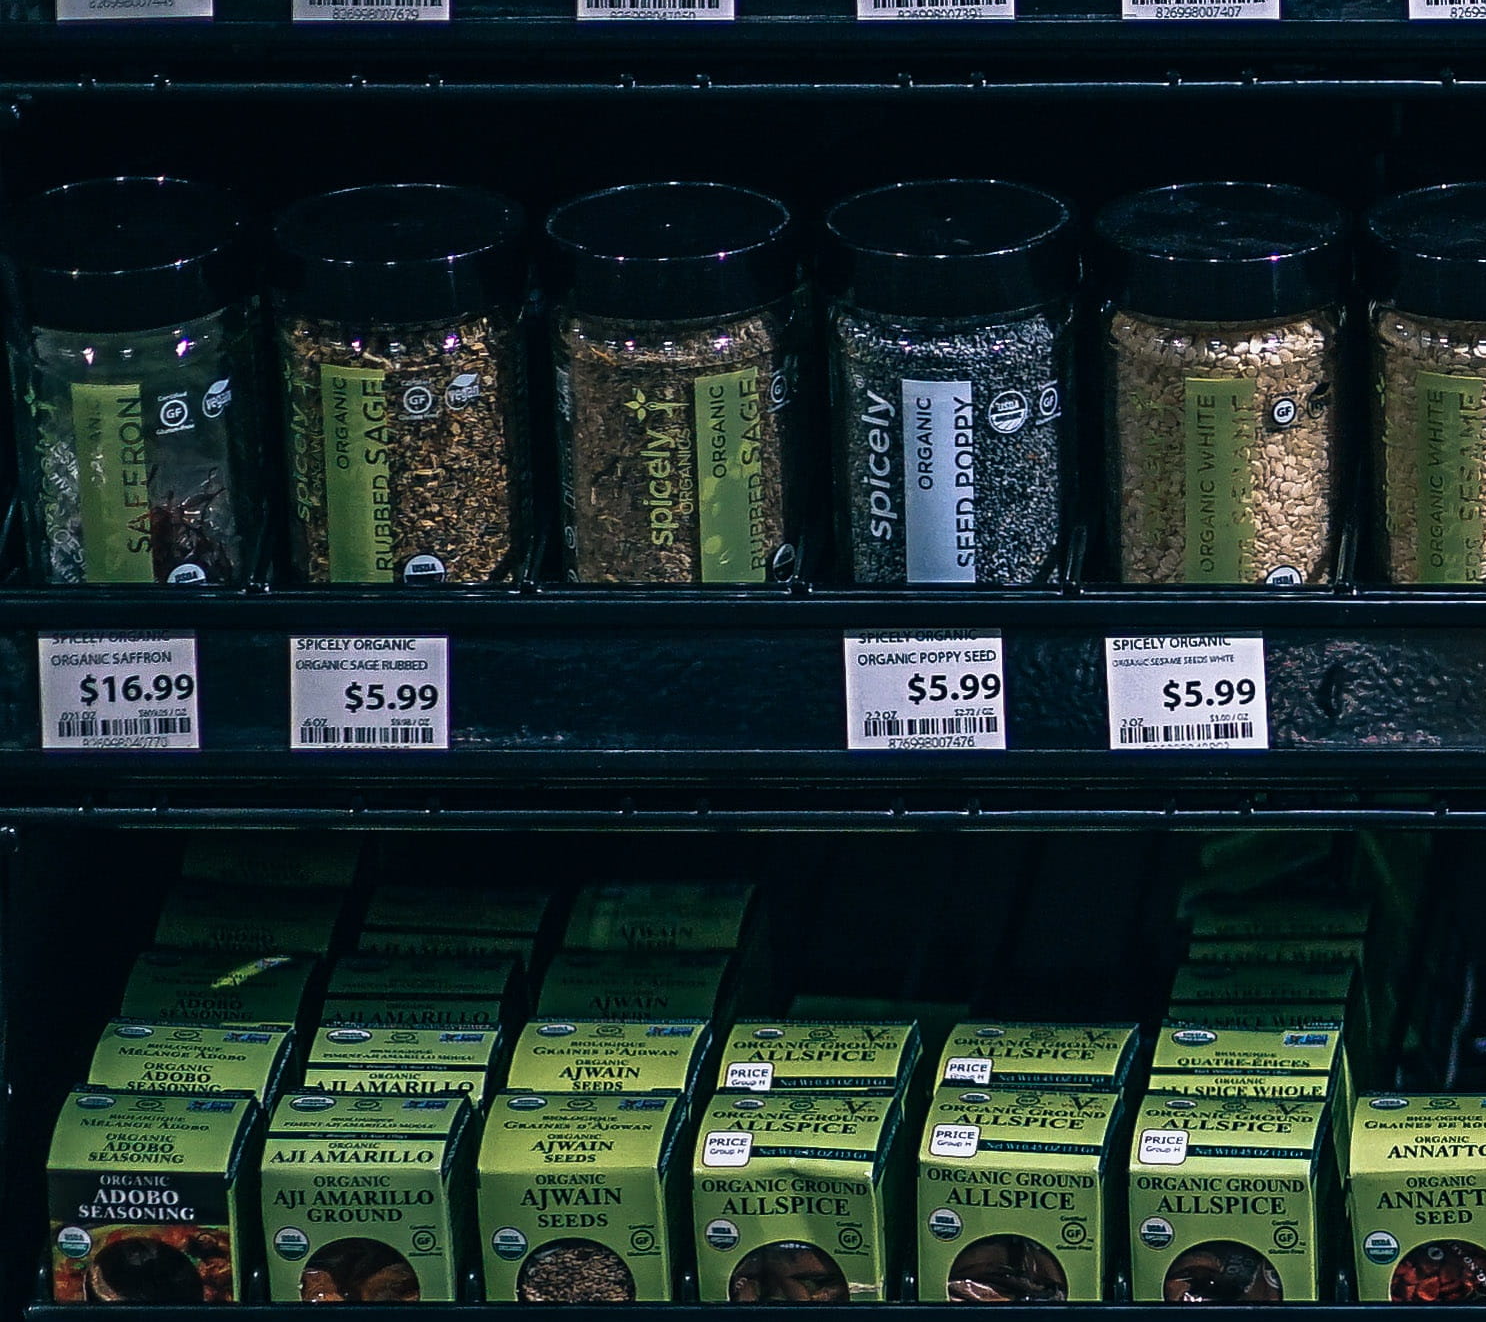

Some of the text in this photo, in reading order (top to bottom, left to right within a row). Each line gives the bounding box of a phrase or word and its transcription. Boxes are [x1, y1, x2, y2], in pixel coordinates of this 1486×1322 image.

[121, 395, 153, 554] SAFFRON
[956, 395, 976, 568] SEED POPPY
[80, 674, 194, 706] $16.99
[935, 1130, 975, 1141] PRICE
[94, 1189, 178, 1205] ADOBO
[520, 1188, 621, 1211] AJWAIN
[79, 1205, 194, 1220] SEASONING
